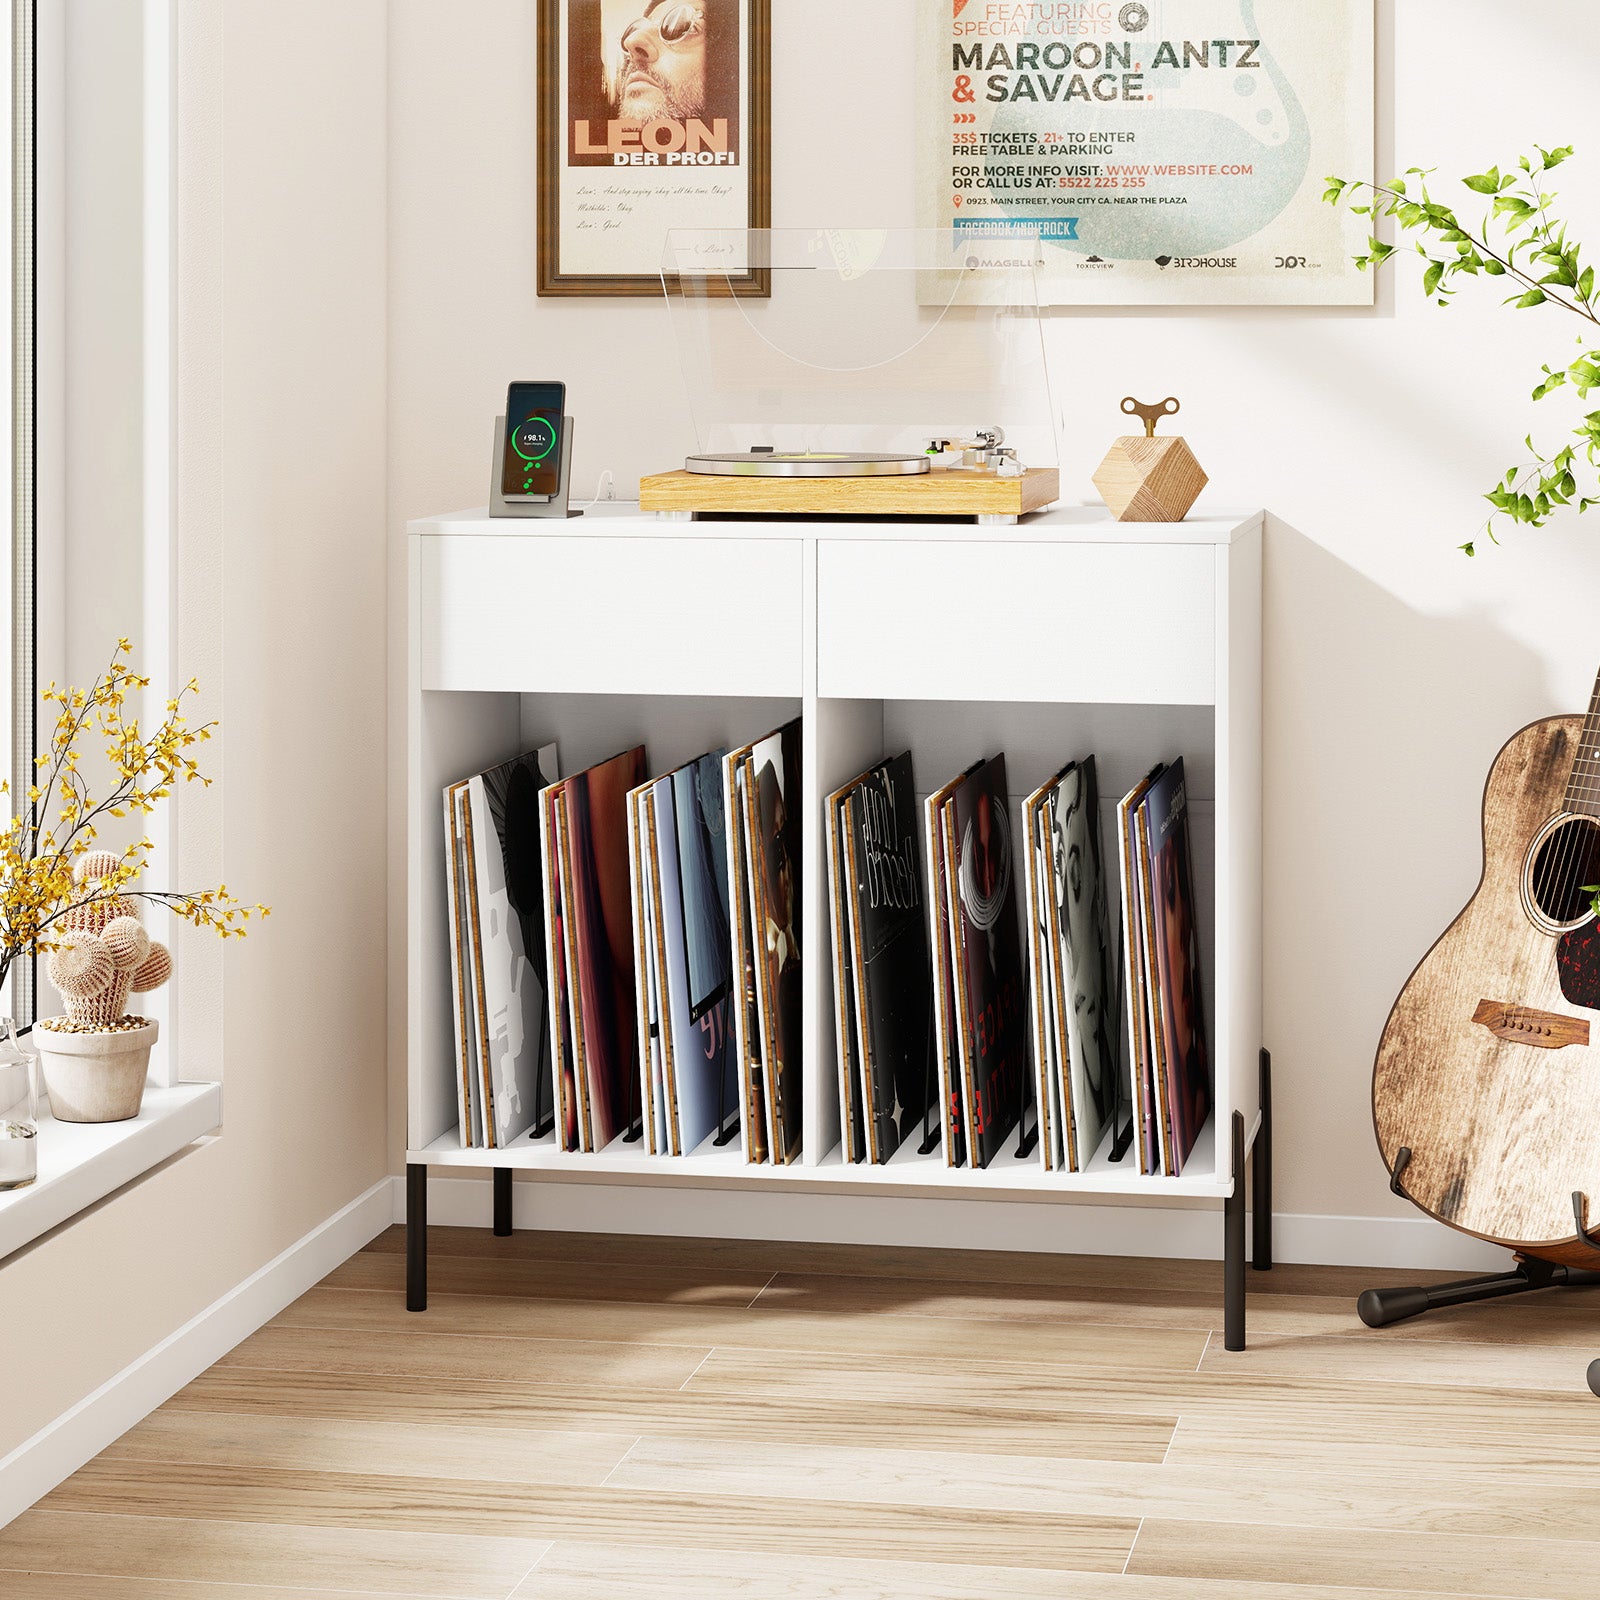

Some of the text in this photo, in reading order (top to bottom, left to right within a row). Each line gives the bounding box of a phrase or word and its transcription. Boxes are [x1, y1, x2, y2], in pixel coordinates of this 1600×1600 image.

[986, 4, 1112, 20] FEATURING
[953, 20, 1112, 36] SPECIAL GUESTS
[952, 40, 1260, 72] MAROON, ANTZ
[952, 73, 1154, 103] & SAVAGE.
[575, 118, 728, 154] LEON
[953, 132, 1135, 145] 35$ TICKETS, 21+ TO ENTER
[952, 144, 1113, 156] FREE TABLE & PARKING
[614, 152, 735, 166] DER PROFI
[952, 165, 1253, 177] FOR MORE INFO VISIT: WWW.WEBSITE.COM
[952, 177, 1146, 188] OR CALL US AT: 5522 225 255
[1114, 197, 1138, 205] NEAR
[1140, 197, 1157, 205] THE
[1159, 197, 1188, 205] PLAZA
[1174, 257, 1237, 268] BIRDHOUSE
